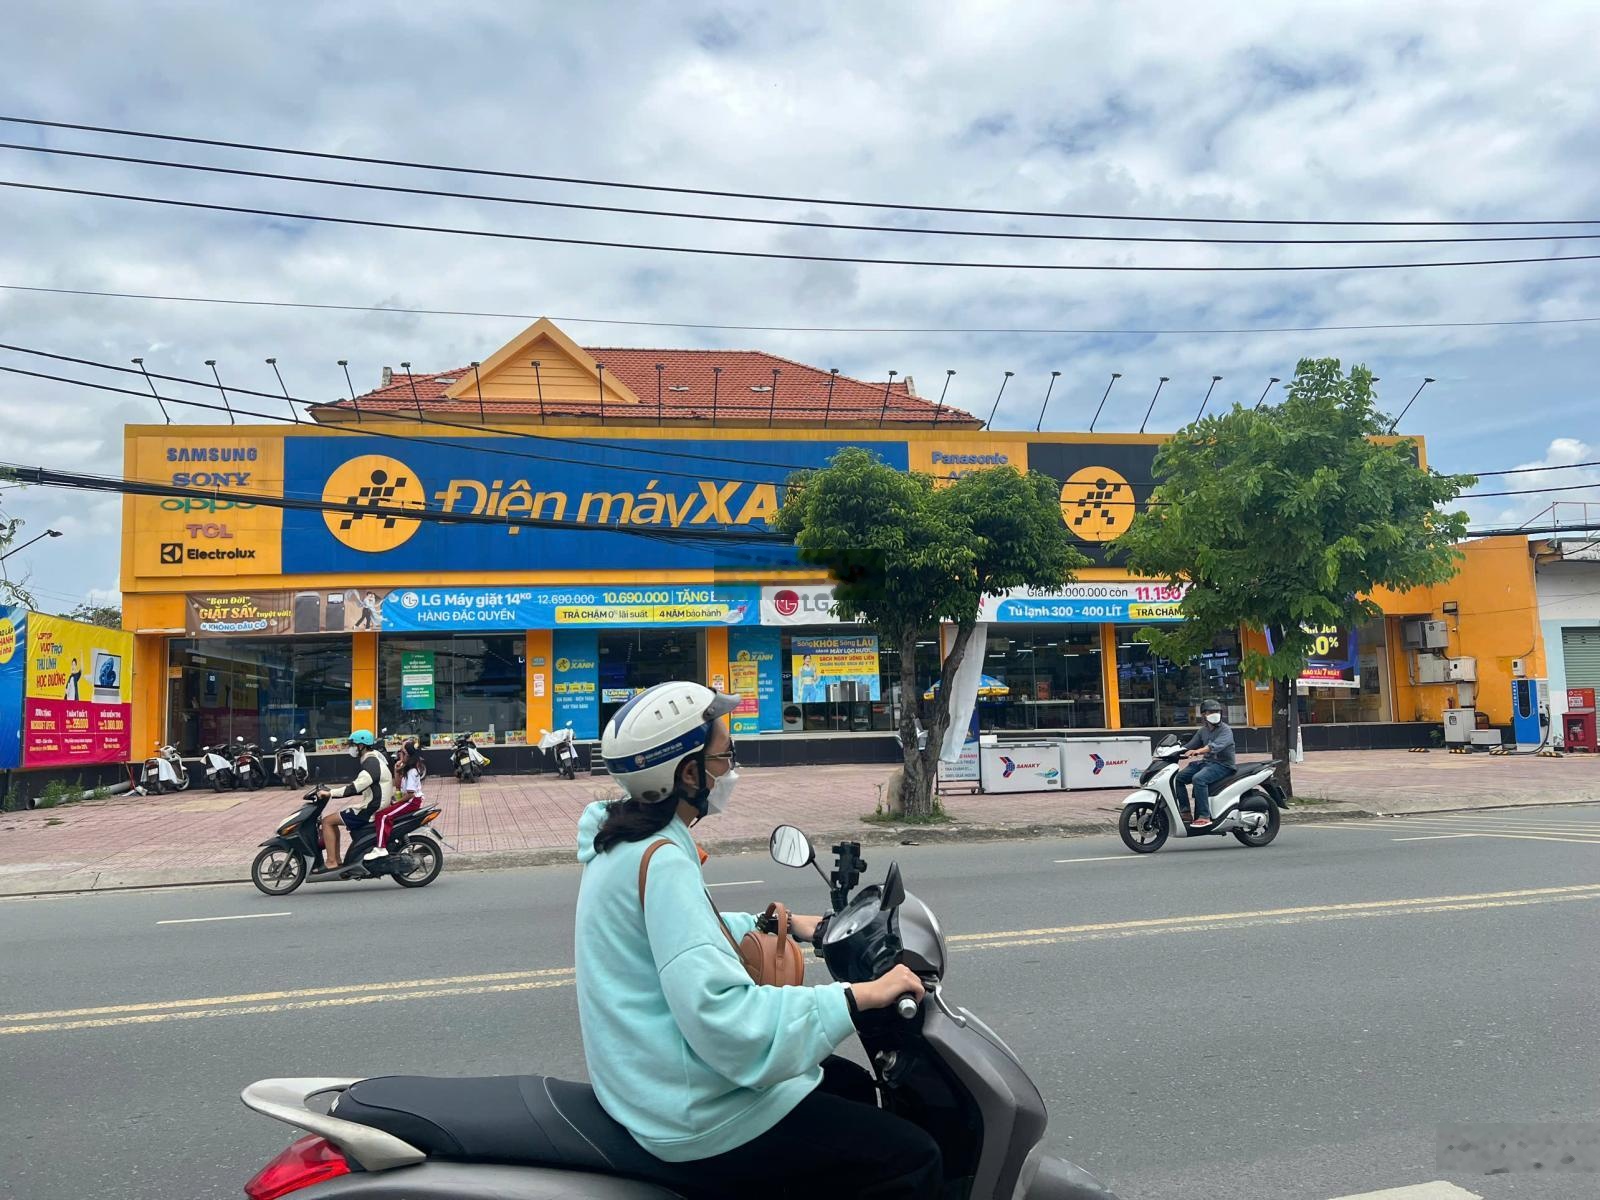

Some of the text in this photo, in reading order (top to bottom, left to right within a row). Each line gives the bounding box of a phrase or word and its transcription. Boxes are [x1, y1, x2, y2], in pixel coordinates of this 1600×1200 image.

[166, 447, 257, 462] SAMSUNG
[932, 451, 1008, 464] Panasonic
[172, 472, 251, 487] SONY
[186, 523, 234, 538] TCL
[187, 547, 256, 560] Electrolux
[421, 594, 441, 605] LG
[444, 592, 472, 608] Máy
[475, 592, 503, 608] giặt
[538, 594, 595, 604] 12.690.000
[602, 591, 669, 603] 10.690.000
[1109, 588, 1128, 597] còn
[803, 592, 829, 612] LG
[230, 602, 258, 618] SẤY
[417, 609, 450, 622] HÀNG
[477, 608, 515, 621] QUYỀN
[1008, 604, 1023, 616] Tủ
[1025, 605, 1050, 619] lạnh
[1051, 606, 1073, 616] 300
[1082, 606, 1104, 616] 400
[1105, 603, 1122, 616] LÍT
